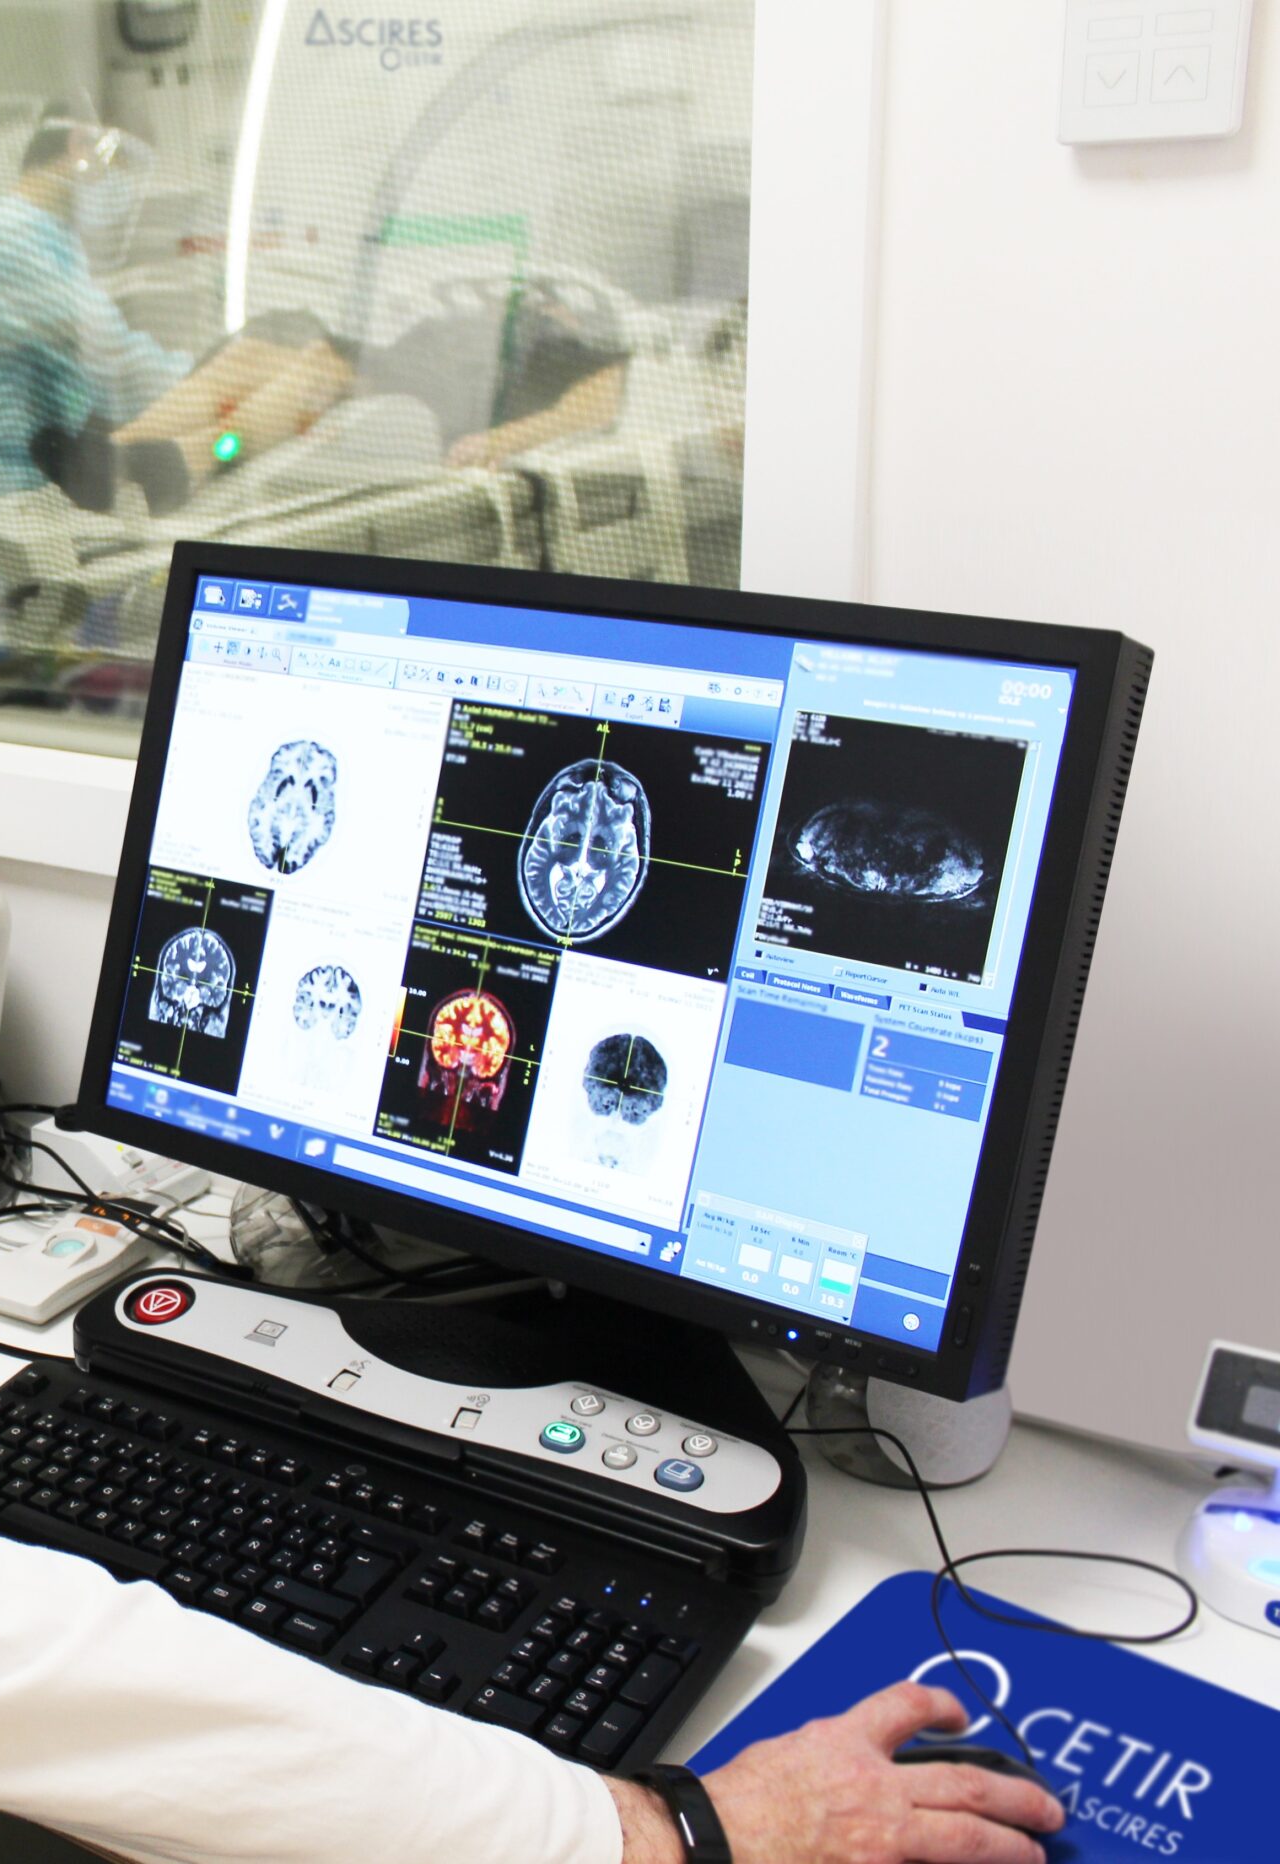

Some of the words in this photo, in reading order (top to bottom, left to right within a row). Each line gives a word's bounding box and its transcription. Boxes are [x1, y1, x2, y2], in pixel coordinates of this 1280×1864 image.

[1001, 680, 1053, 698] 00:00
[740, 969, 755, 980] Coil
[773, 976, 801, 990] Protocol
[802, 983, 821, 995] Notes
[736, 984, 757, 997] Scan
[759, 988, 780, 1001] Time
[781, 994, 828, 1013] Remaining
[840, 990, 879, 1006] Waveforms
[898, 1003, 912, 1013] PET
[913, 1006, 929, 1017] Scan
[930, 1009, 953, 1021] Status
[873, 1013, 906, 1029] System
[907, 1020, 953, 1038] Countrate
[871, 1034, 890, 1058] 2
[798, 1237, 811, 1248] Min
[827, 1246, 848, 1258] Room
[969, 1263, 981, 1272] PIP
[741, 1270, 759, 1284] 0.0
[782, 1282, 800, 1296] 0.0
[815, 1329, 833, 1340] INPUT
[844, 1336, 863, 1348] MENU
[292, 1617, 317, 1631] Control
[1017, 1708, 1212, 1820] CETIR
[1060, 1780, 1184, 1856] ASCIRES
